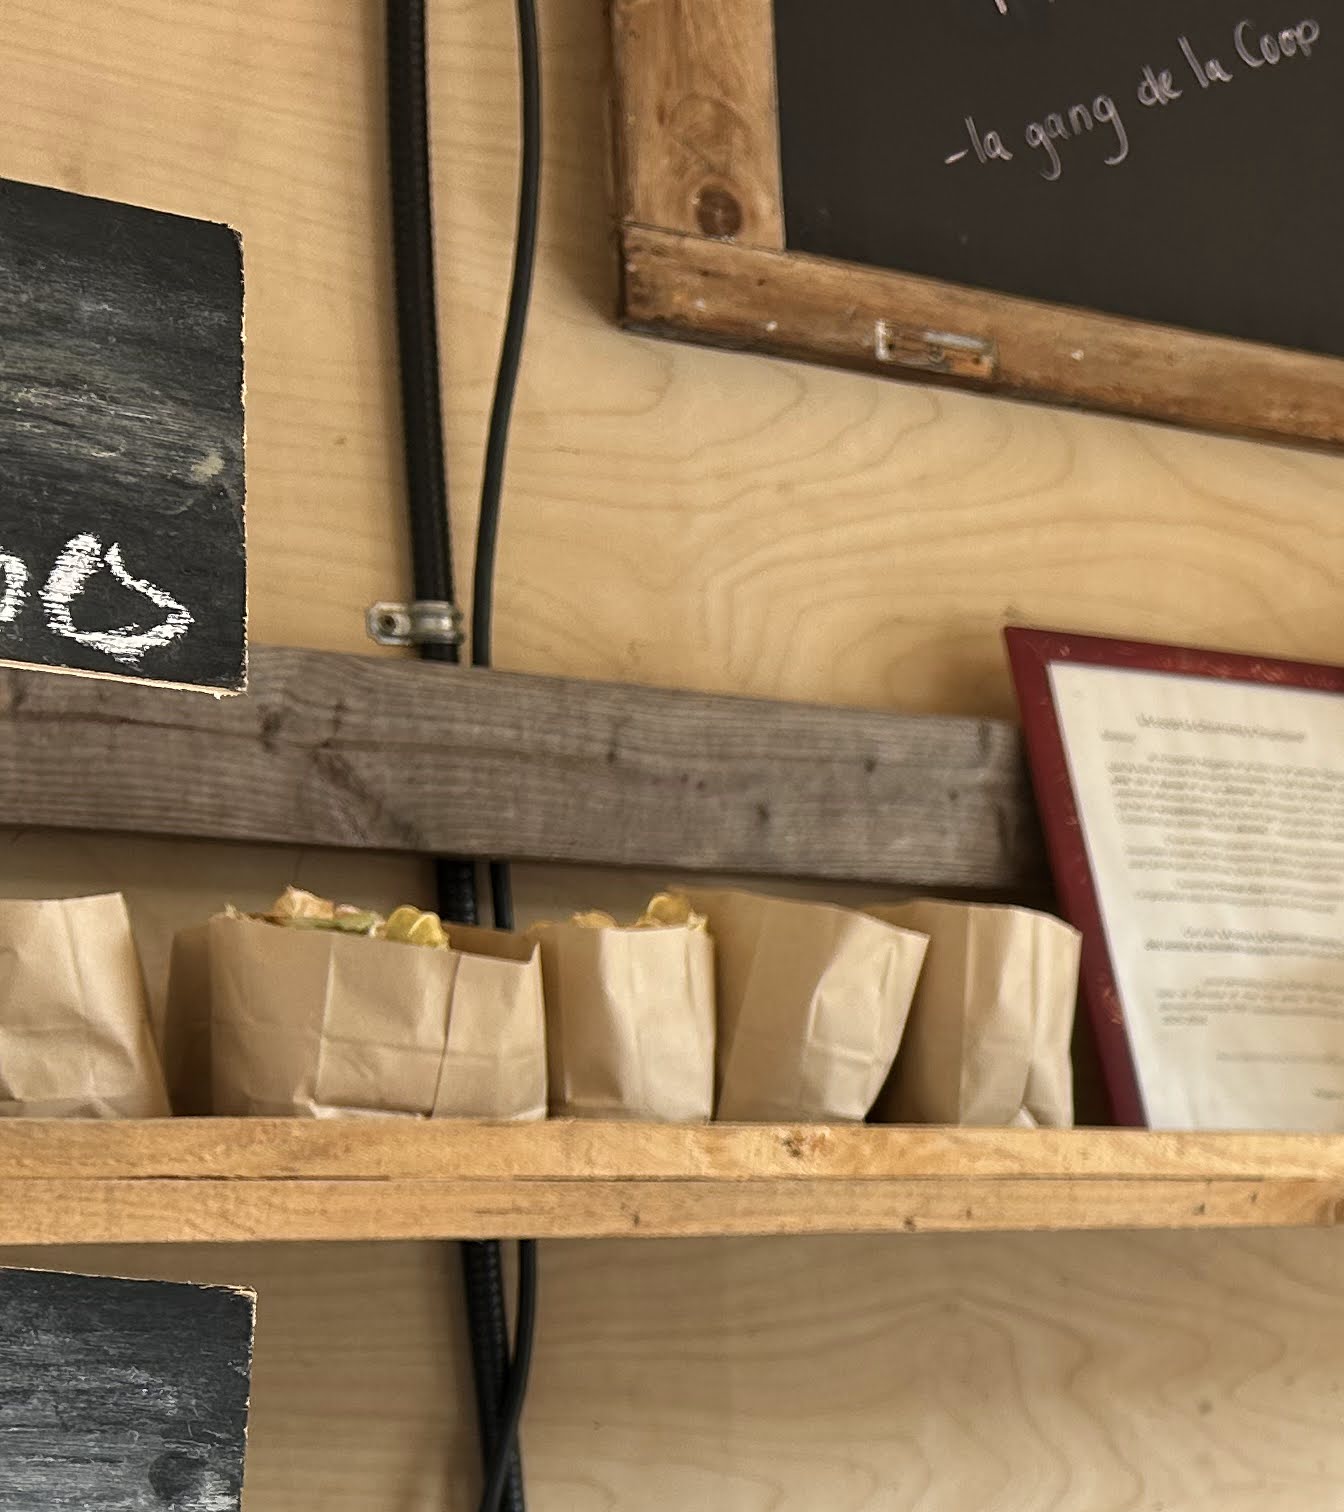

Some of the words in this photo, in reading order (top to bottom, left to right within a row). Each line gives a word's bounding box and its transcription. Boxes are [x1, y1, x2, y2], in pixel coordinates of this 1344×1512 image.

[1025, 94, 1129, 181] gang
[1137, 65, 1182, 106] de
[1178, 36, 1233, 88] la
[1233, 19, 1320, 68] Coop
